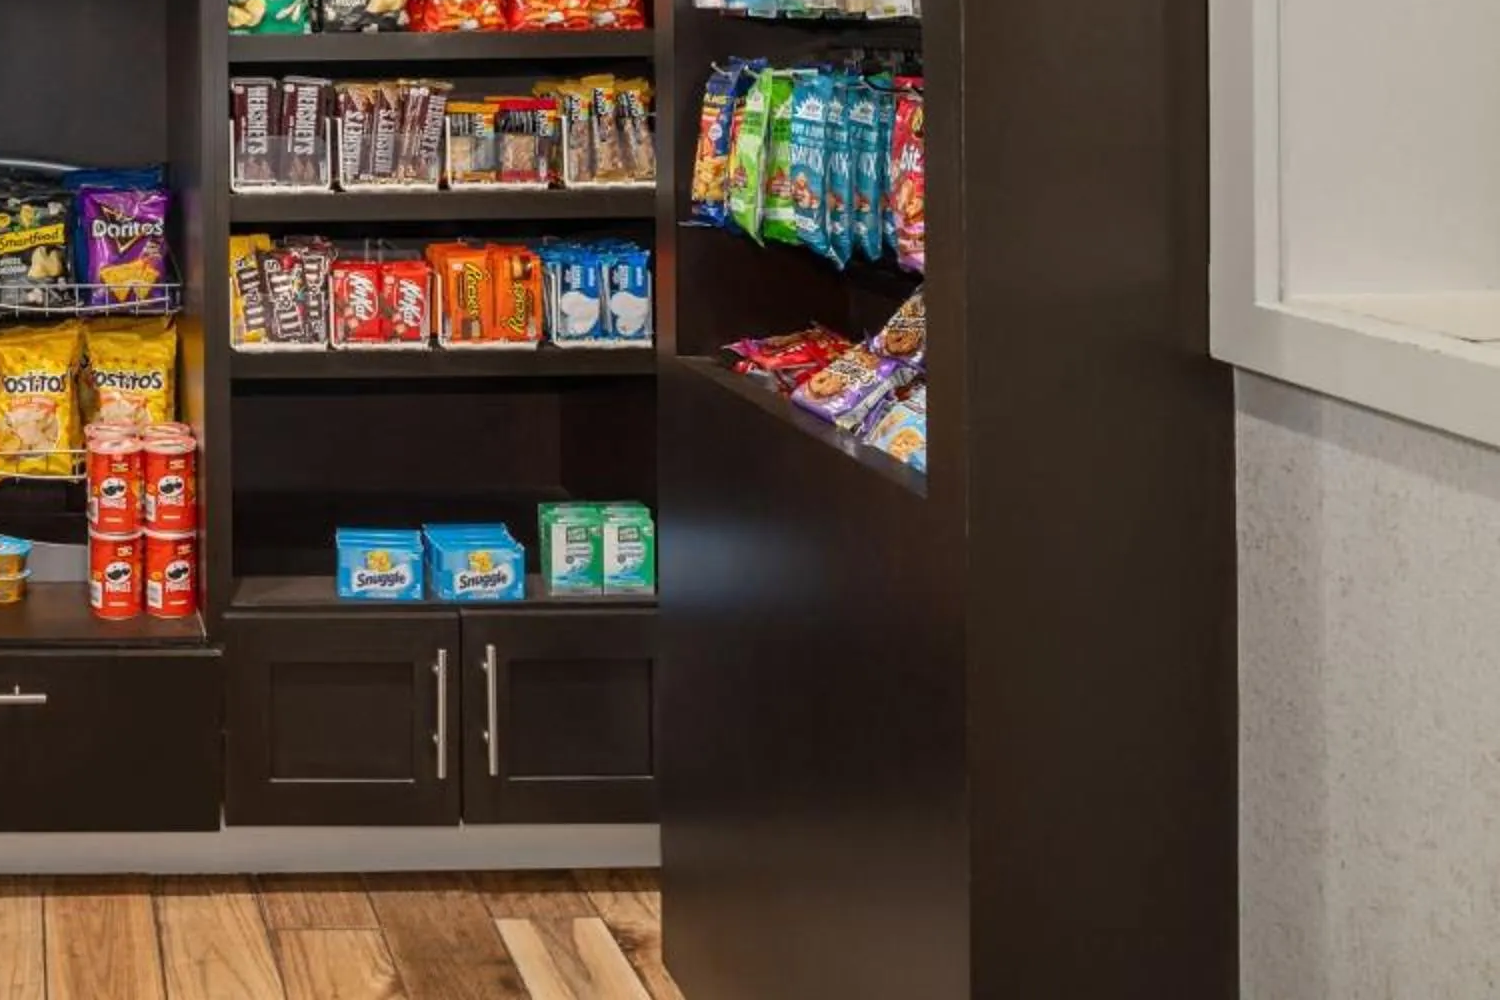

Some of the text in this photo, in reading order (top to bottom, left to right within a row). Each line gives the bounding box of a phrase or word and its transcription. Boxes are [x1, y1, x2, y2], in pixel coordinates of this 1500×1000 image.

[247, 85, 269, 154] HERSHEY'S
[294, 84, 319, 155] HERSHEY'S
[91, 217, 164, 240] Doritos
[355, 572, 406, 589] Snuggle
[458, 572, 508, 590] Snuggle
